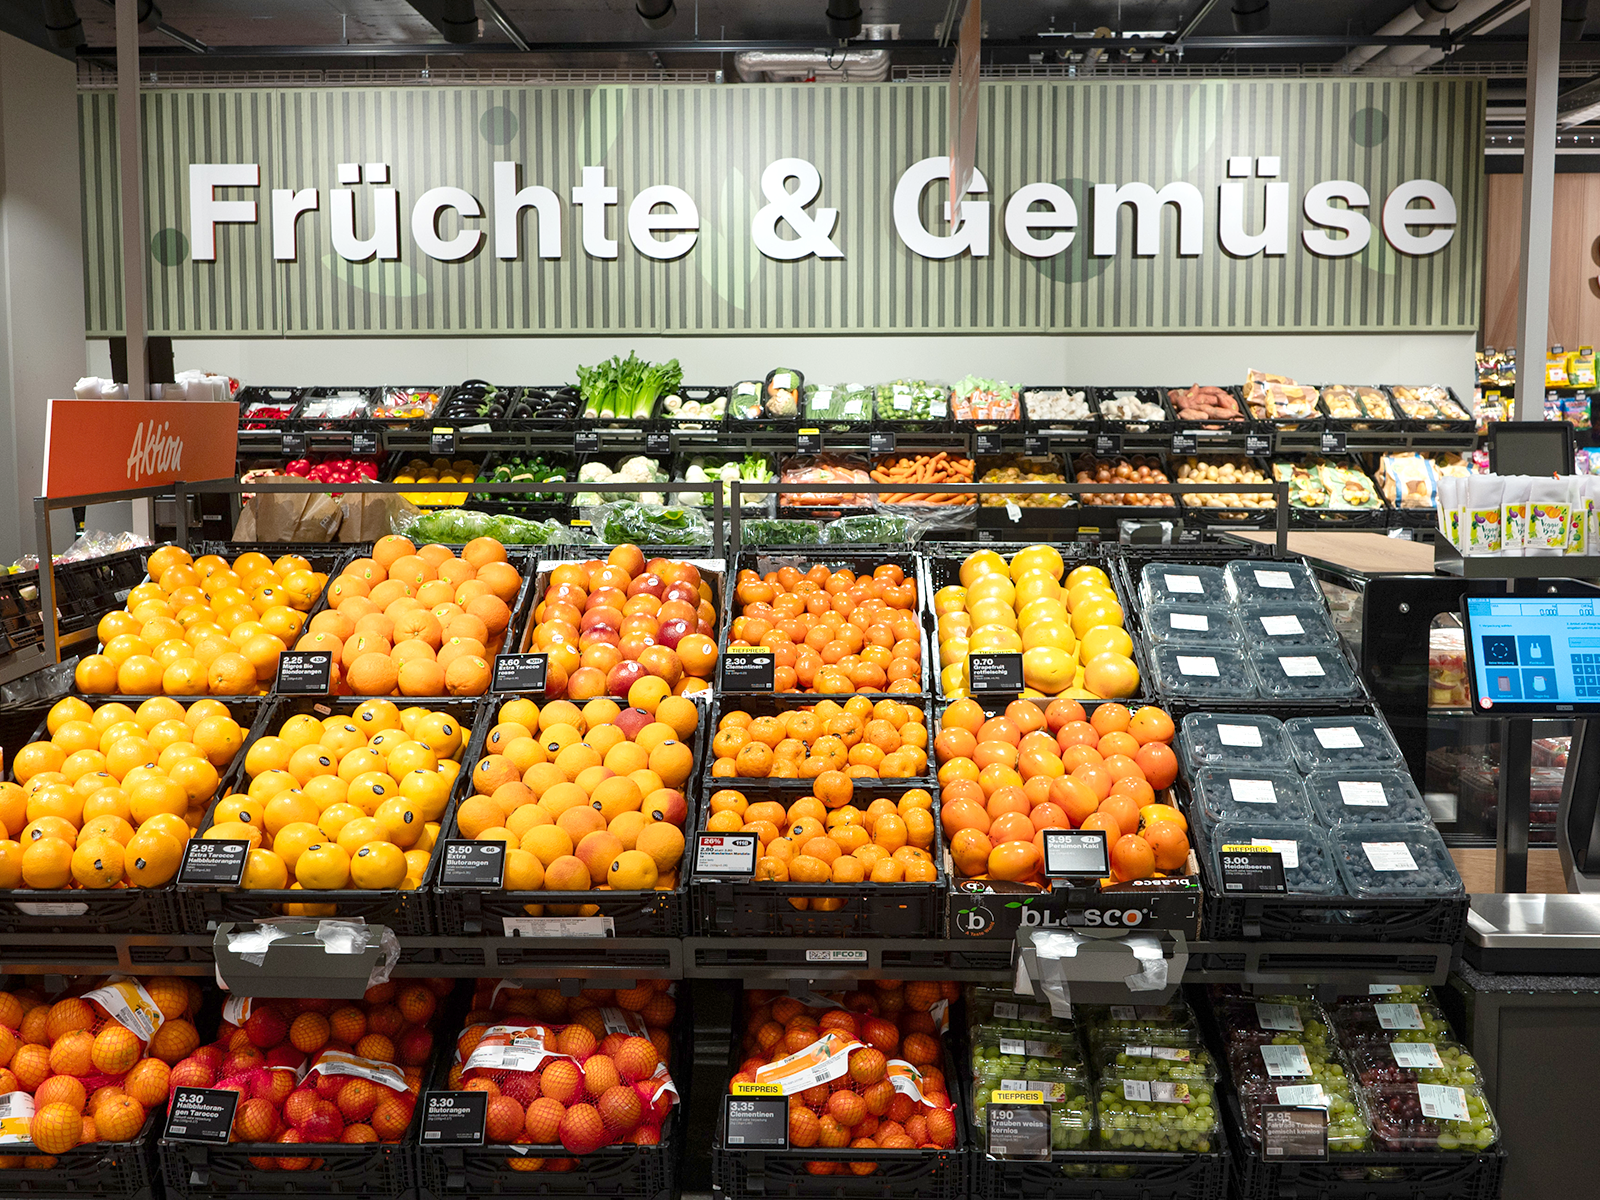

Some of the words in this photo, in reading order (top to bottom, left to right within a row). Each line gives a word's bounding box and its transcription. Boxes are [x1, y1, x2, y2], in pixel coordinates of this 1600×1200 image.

[189, 160, 699, 262] Früchte
[752, 157, 845, 260] &
[893, 155, 1457, 260] Gemüse
[127, 419, 183, 481] Aktion
[283, 656, 303, 664] 2.25
[725, 657, 747, 665] 2.30
[1048, 835, 1072, 844] 3.95
[190, 844, 215, 852] 2.95
[448, 845, 473, 854] 3.50
[187, 857, 241, 865] Halbblutorangen
[1223, 856, 1249, 865] 3.00
[738, 1085, 779, 1093] TIEFPREIS
[178, 1093, 204, 1104] 3.30
[997, 1093, 1039, 1101] TIEFPREIS
[176, 1102, 225, 1112] Halbblutoran-
[429, 1098, 454, 1107] 3.30
[730, 1102, 755, 1111] 3.35
[189, 1109, 219, 1118] Tarocco
[428, 1107, 471, 1115] Blutorangen
[991, 1110, 1014, 1120] 1.90
[1266, 1112, 1292, 1122] 2.95
[1022, 1120, 1044, 1128] weiss
[1267, 1128, 1297, 1136] gemischt
